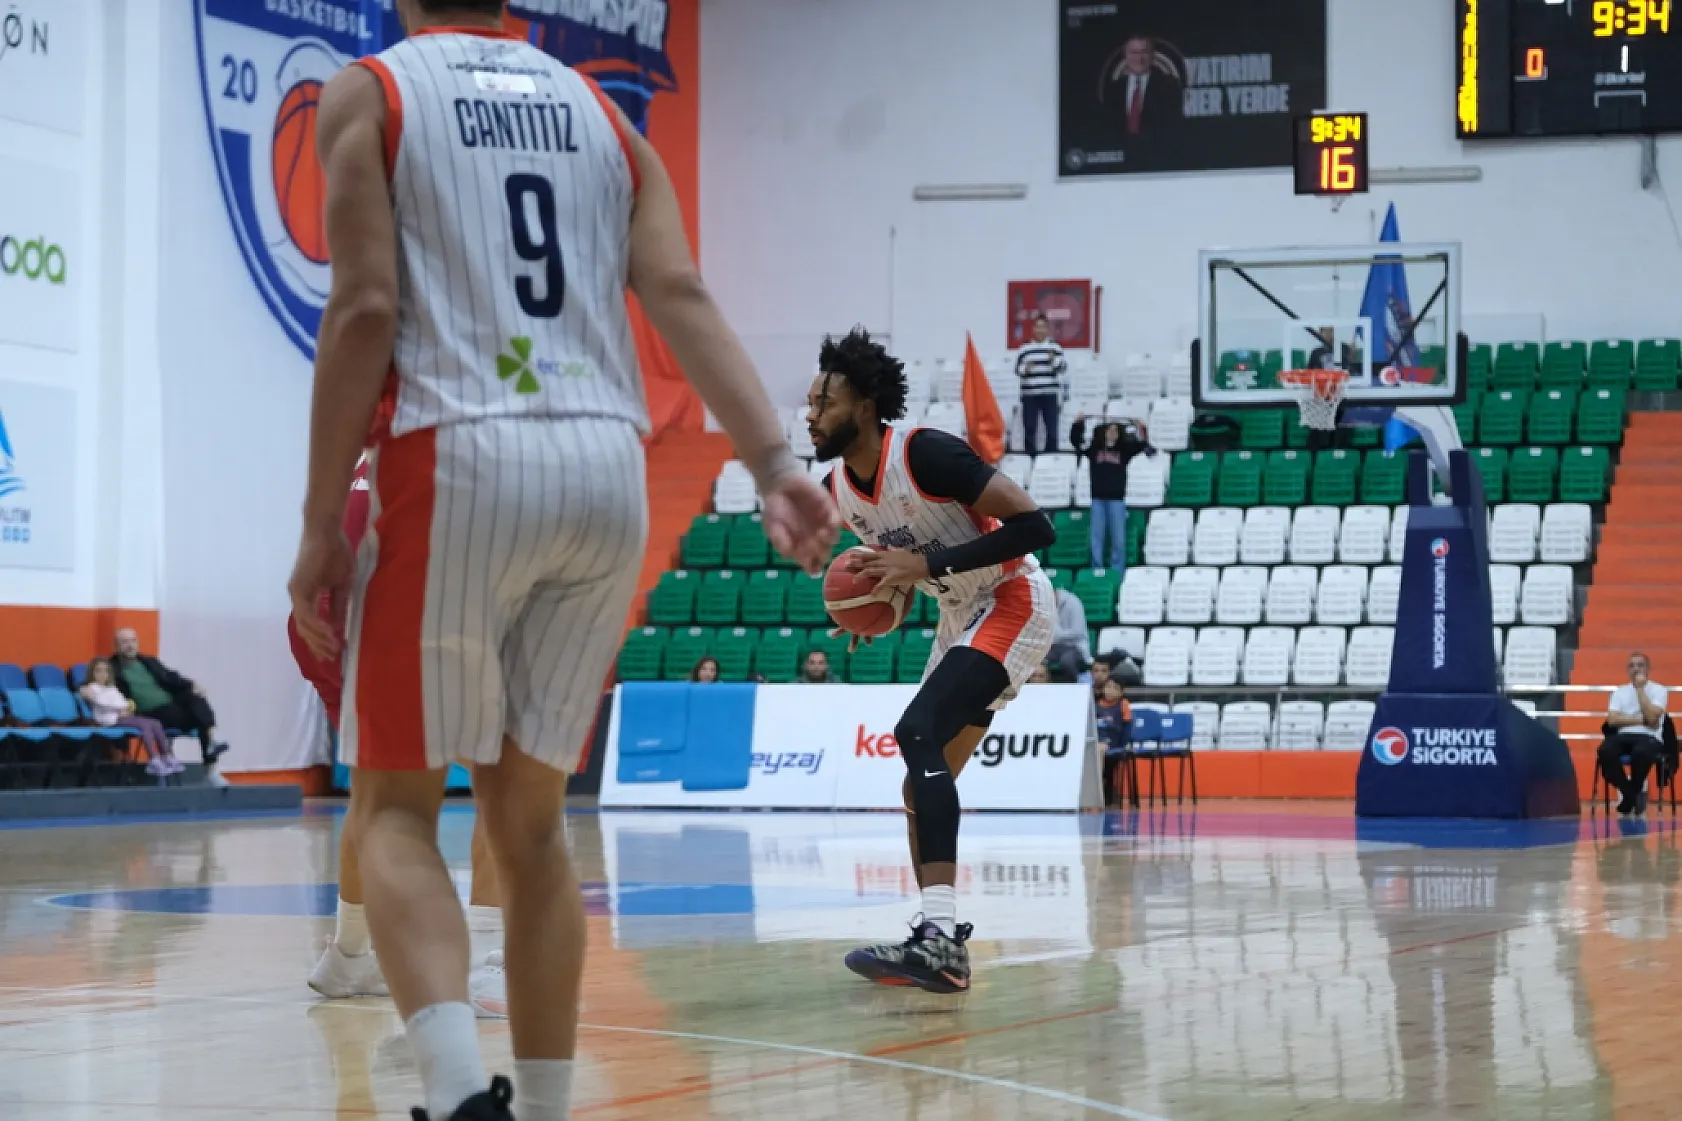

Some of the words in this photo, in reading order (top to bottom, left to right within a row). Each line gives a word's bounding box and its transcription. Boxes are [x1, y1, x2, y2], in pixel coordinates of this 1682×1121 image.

[1593, 0, 1668, 36] 9:34
[221, 54, 256, 102] 20
[1527, 48, 1544, 77] 0
[1310, 115, 1361, 143] 9:34
[1320, 146, 1356, 191] 16
[504, 172, 565, 319] 9
